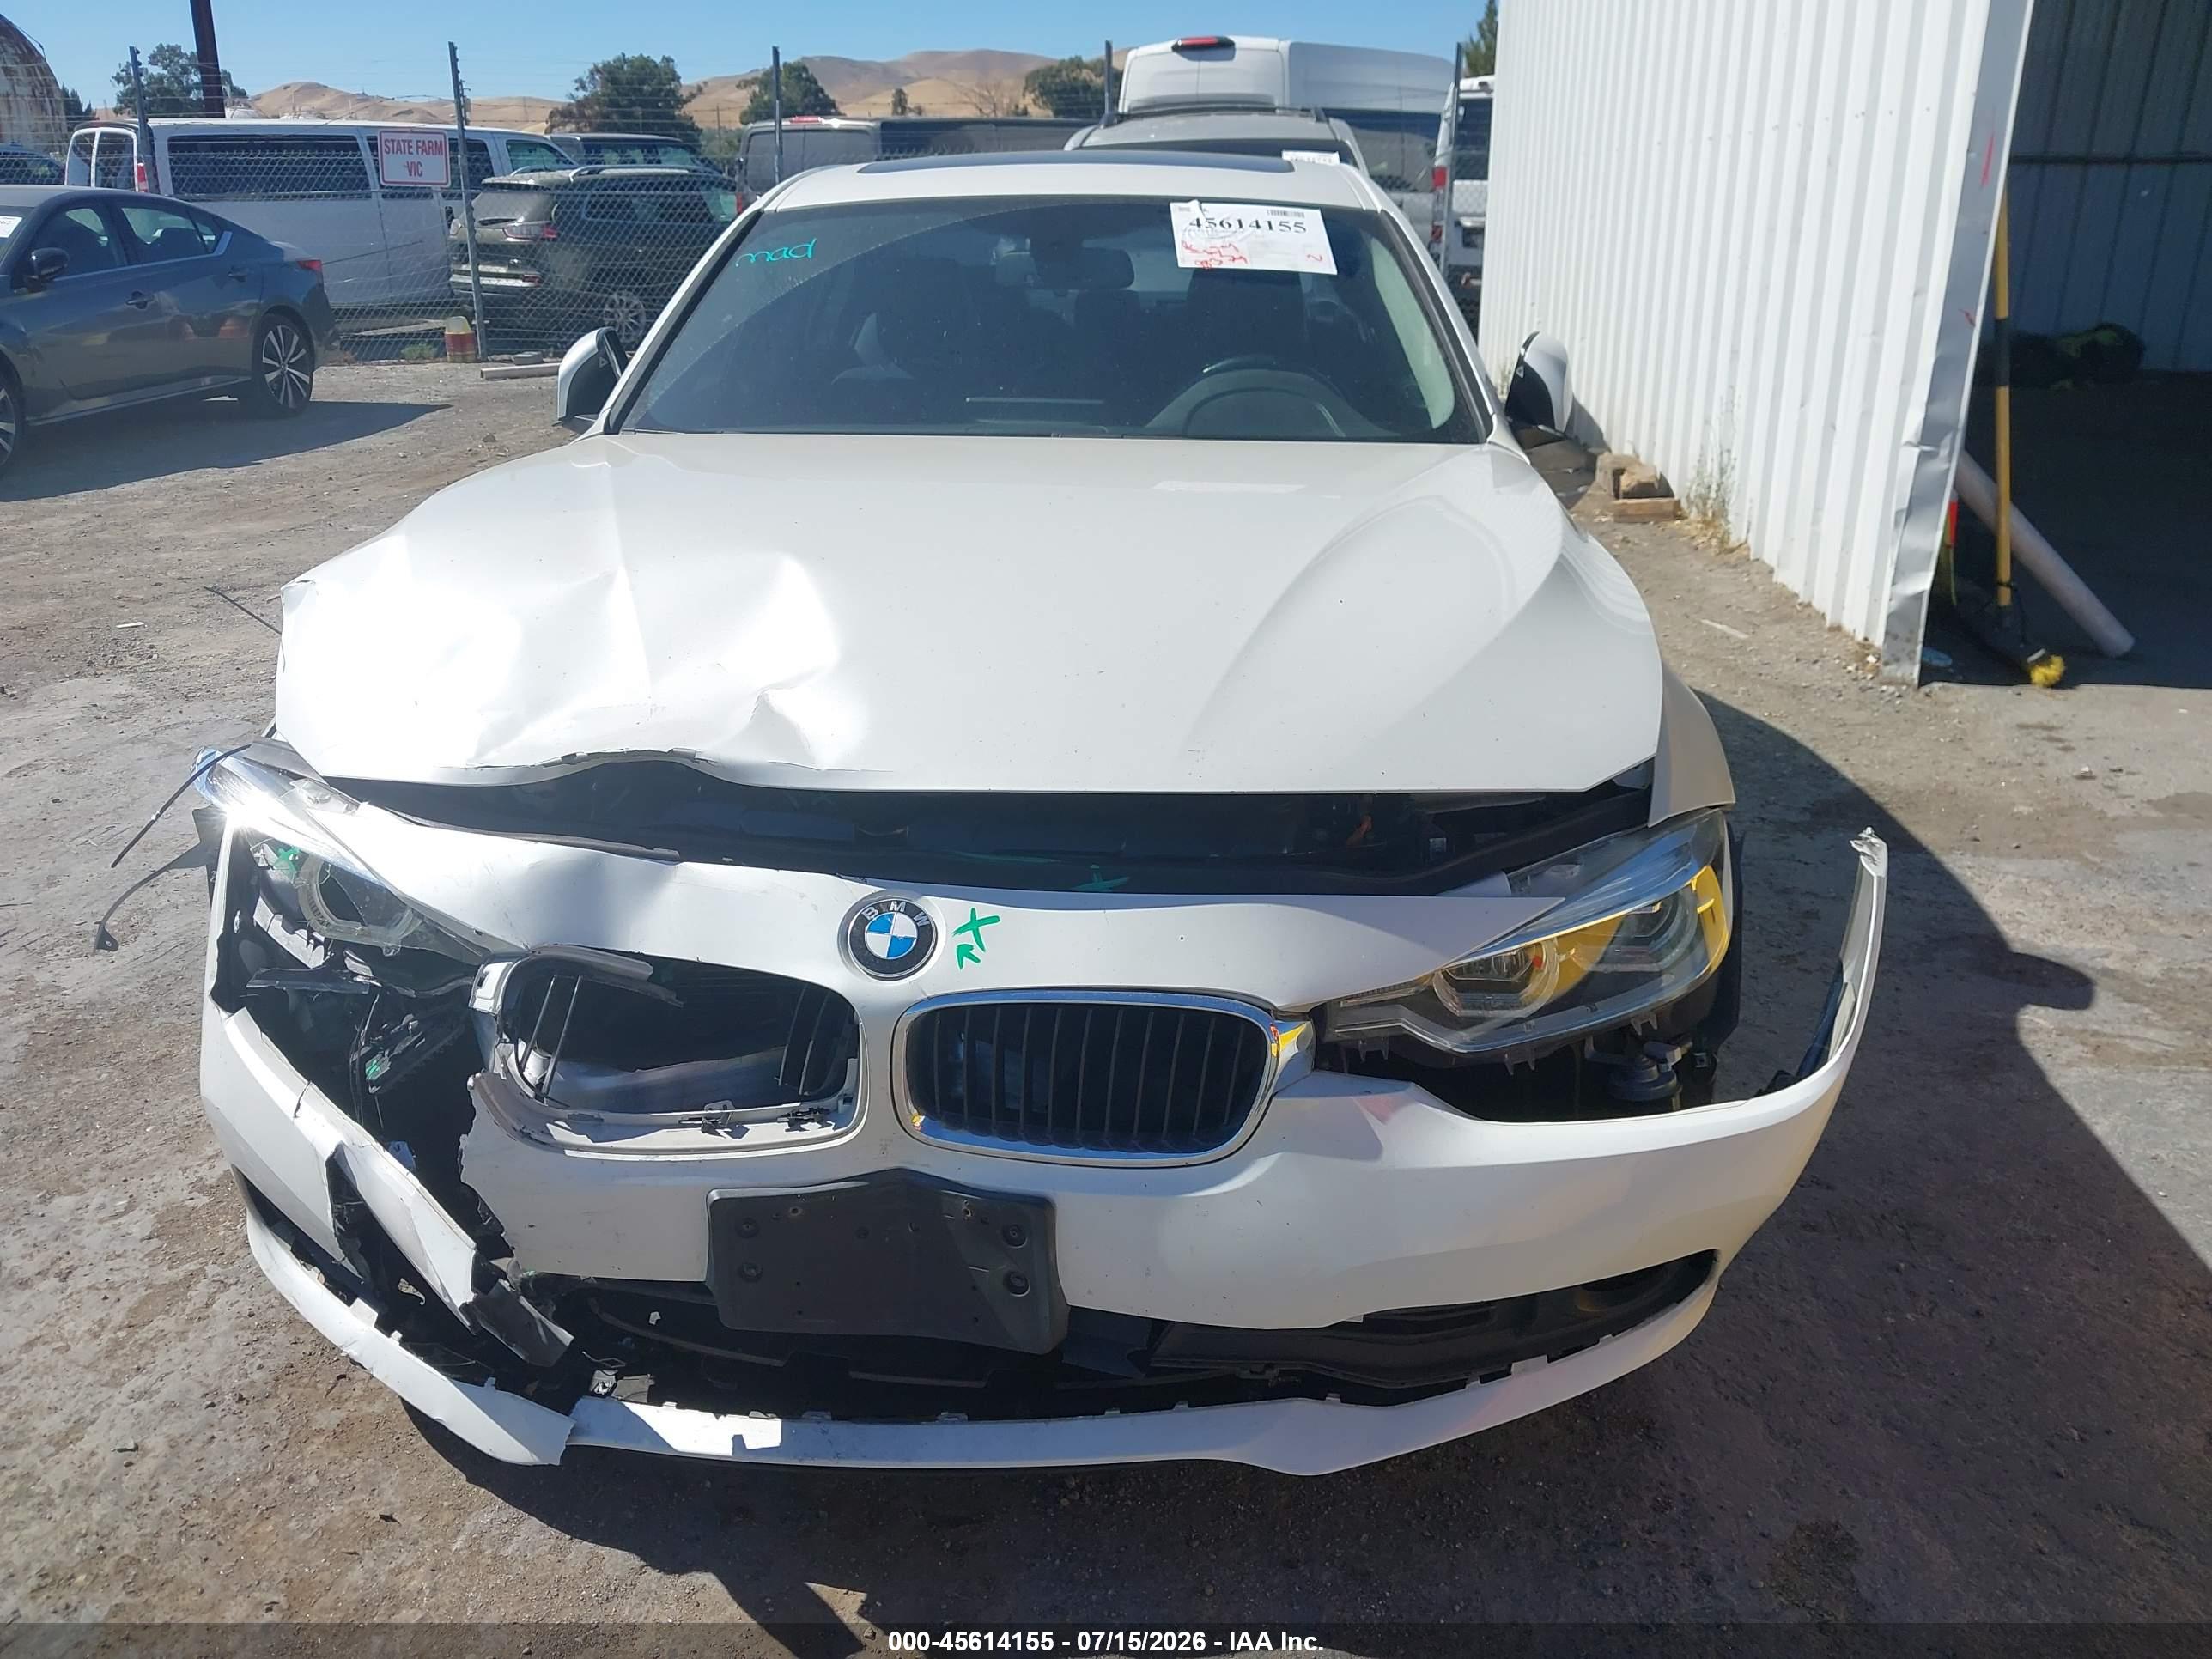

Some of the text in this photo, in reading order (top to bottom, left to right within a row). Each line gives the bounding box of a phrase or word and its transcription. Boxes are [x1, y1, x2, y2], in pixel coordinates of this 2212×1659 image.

[384, 138, 444, 156] STATE FARM
[406, 161, 423, 178] VIC
[1189, 217, 1306, 234] 45614155
[861, 900, 931, 927] BMW
